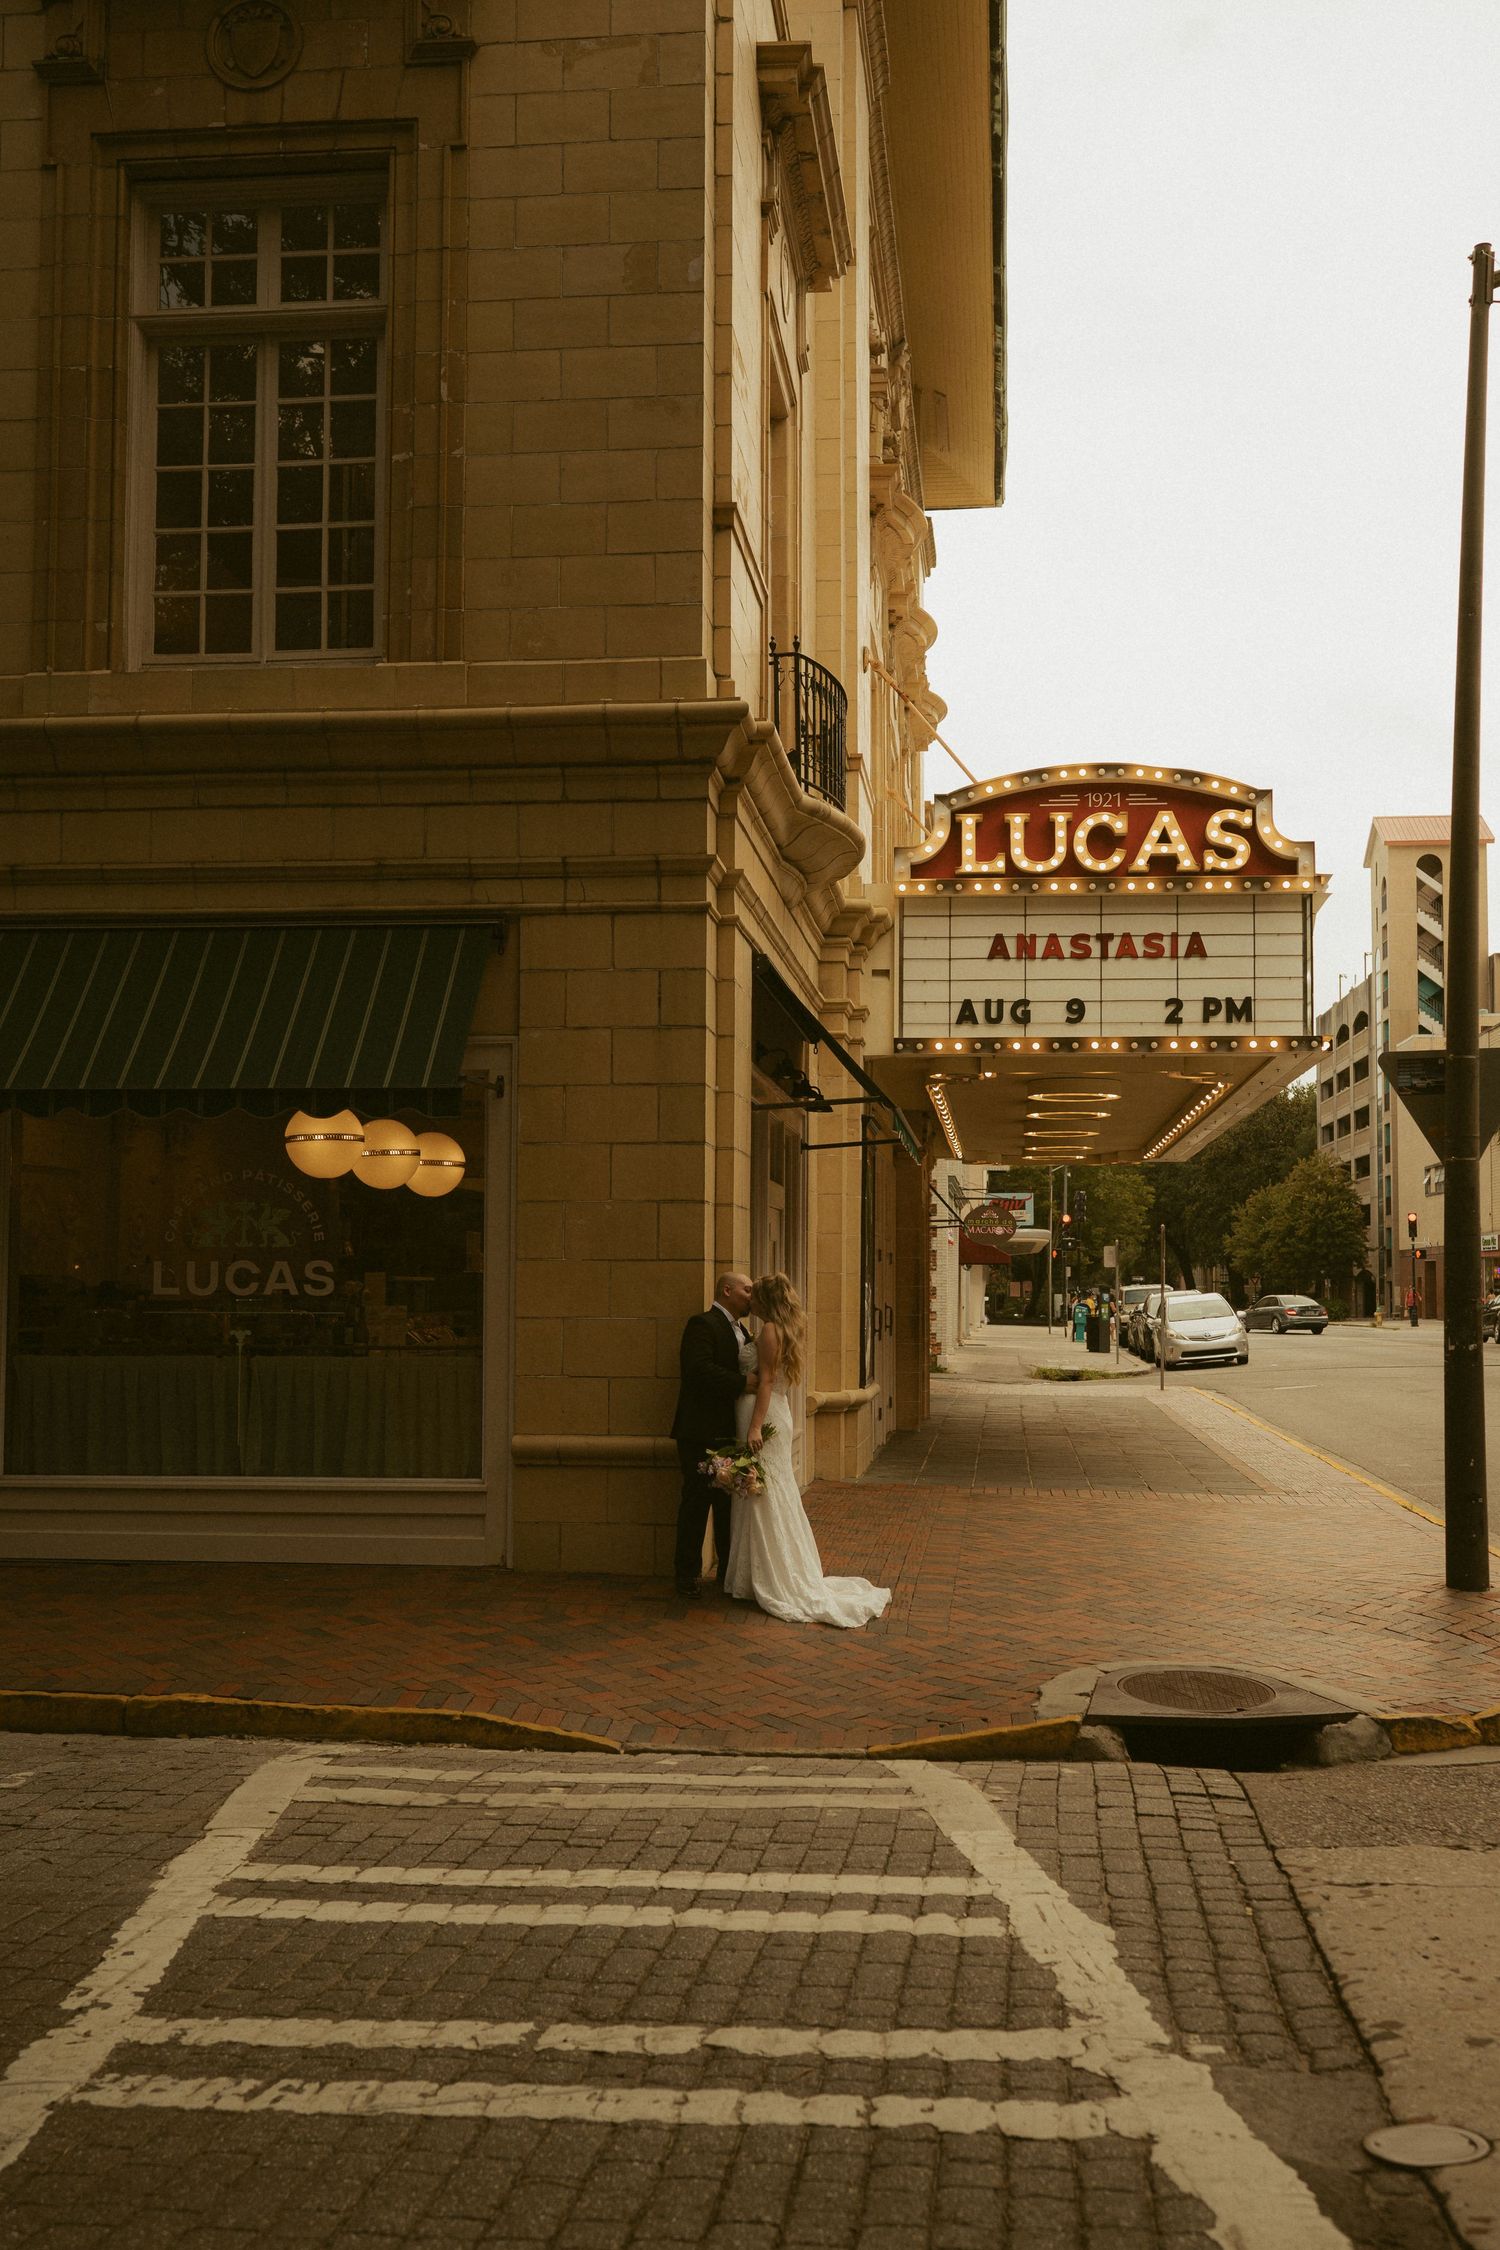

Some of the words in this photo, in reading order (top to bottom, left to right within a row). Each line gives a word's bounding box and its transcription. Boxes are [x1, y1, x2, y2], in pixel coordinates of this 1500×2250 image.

[1084, 792, 1121, 808] 1921
[954, 809, 1253, 875] LUCAS
[987, 932, 1208, 960] ANASTASIA
[955, 998, 1031, 1025] AUG
[1065, 997, 1086, 1024] 9
[1164, 997, 1184, 1024] 2
[1202, 996, 1253, 1023] PM
[242, 1168, 325, 1242] PATISSERIE
[968, 1226, 1014, 1235] MACARONS
[153, 1260, 335, 1296] LUCAS
